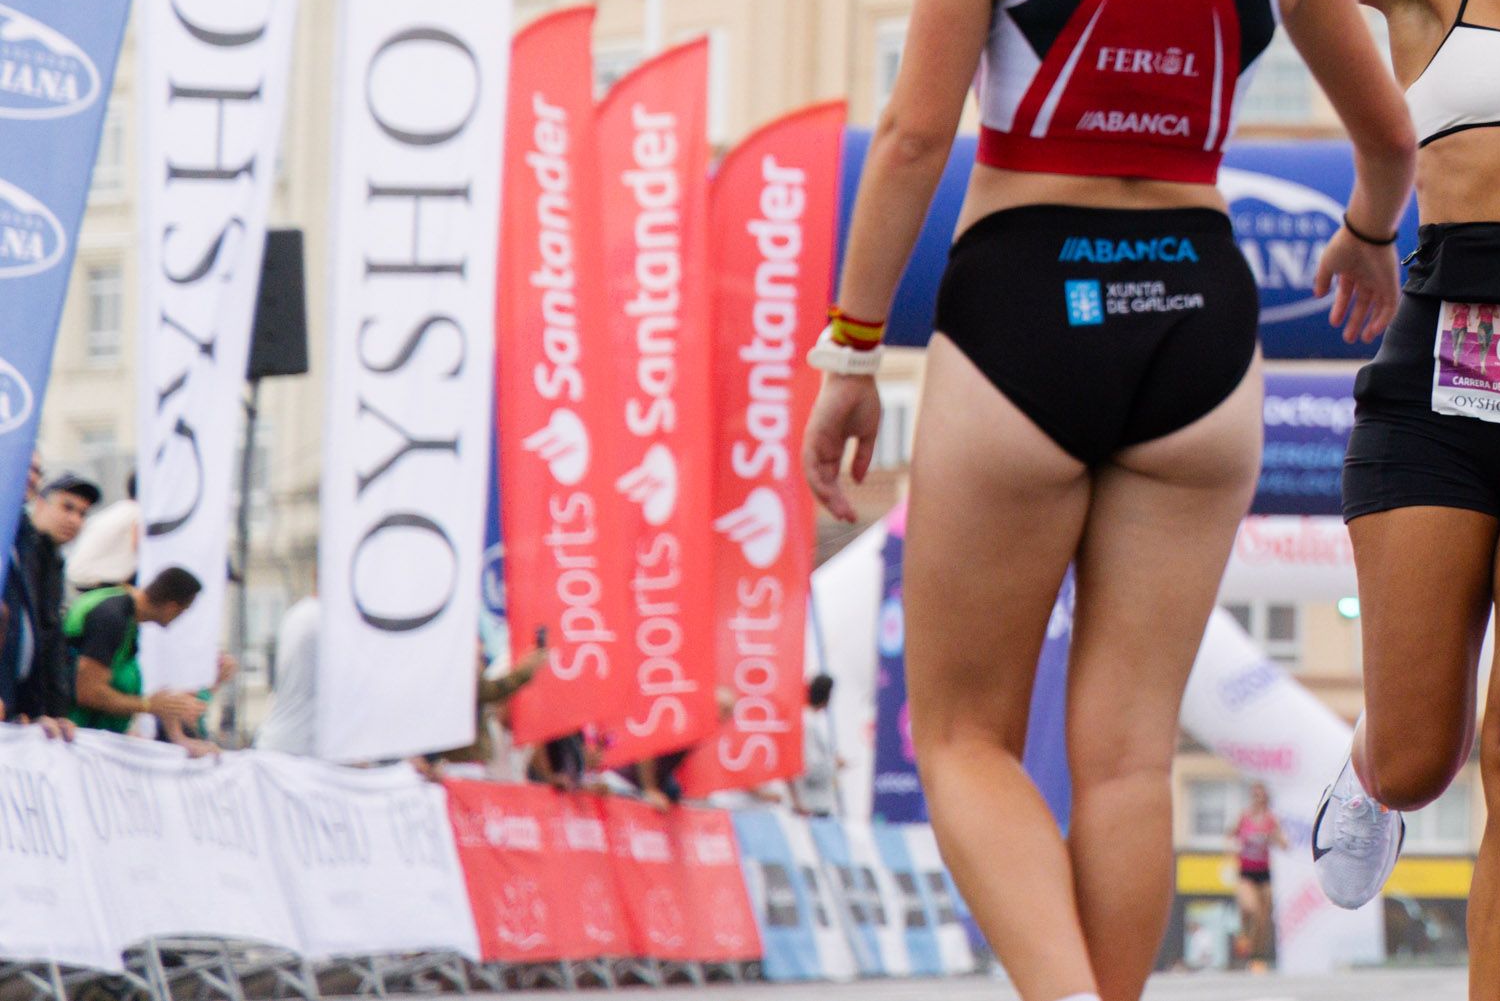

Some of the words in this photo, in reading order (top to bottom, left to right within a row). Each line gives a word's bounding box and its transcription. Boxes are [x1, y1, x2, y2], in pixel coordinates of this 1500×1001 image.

[349, 27, 483, 632] OYSHO
[524, 93, 584, 402] Santander
[622, 103, 683, 437] Santander
[731, 155, 807, 480] Santander
[1105, 281, 1166, 297] XUNTA
[1105, 299, 1130, 314] DE
[1452, 376, 1491, 389] CARRERA
[543, 491, 616, 682] Sports
[626, 532, 698, 738] Sports
[717, 574, 791, 773] Sports
